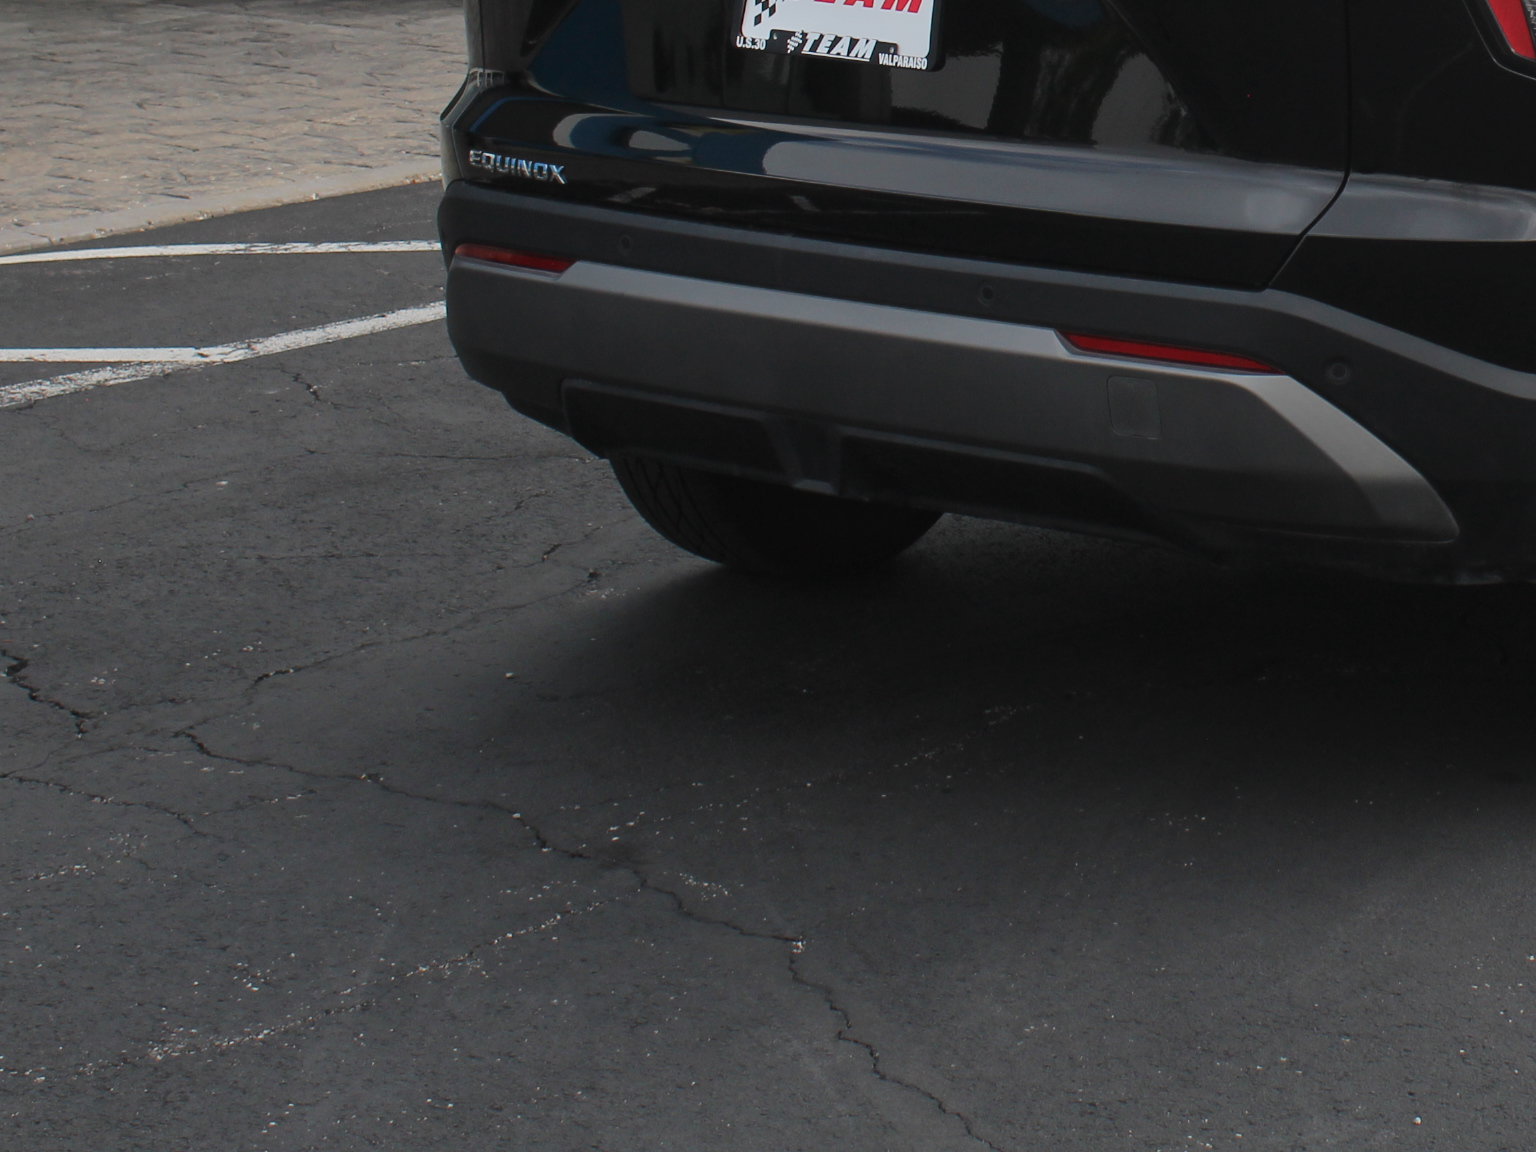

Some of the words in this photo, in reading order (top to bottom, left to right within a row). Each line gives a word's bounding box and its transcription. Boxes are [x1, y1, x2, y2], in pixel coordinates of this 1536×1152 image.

[801, 31, 878, 59] TEAM
[878, 52, 928, 70] VALPARAISO
[468, 149, 567, 185] EQUINOX
